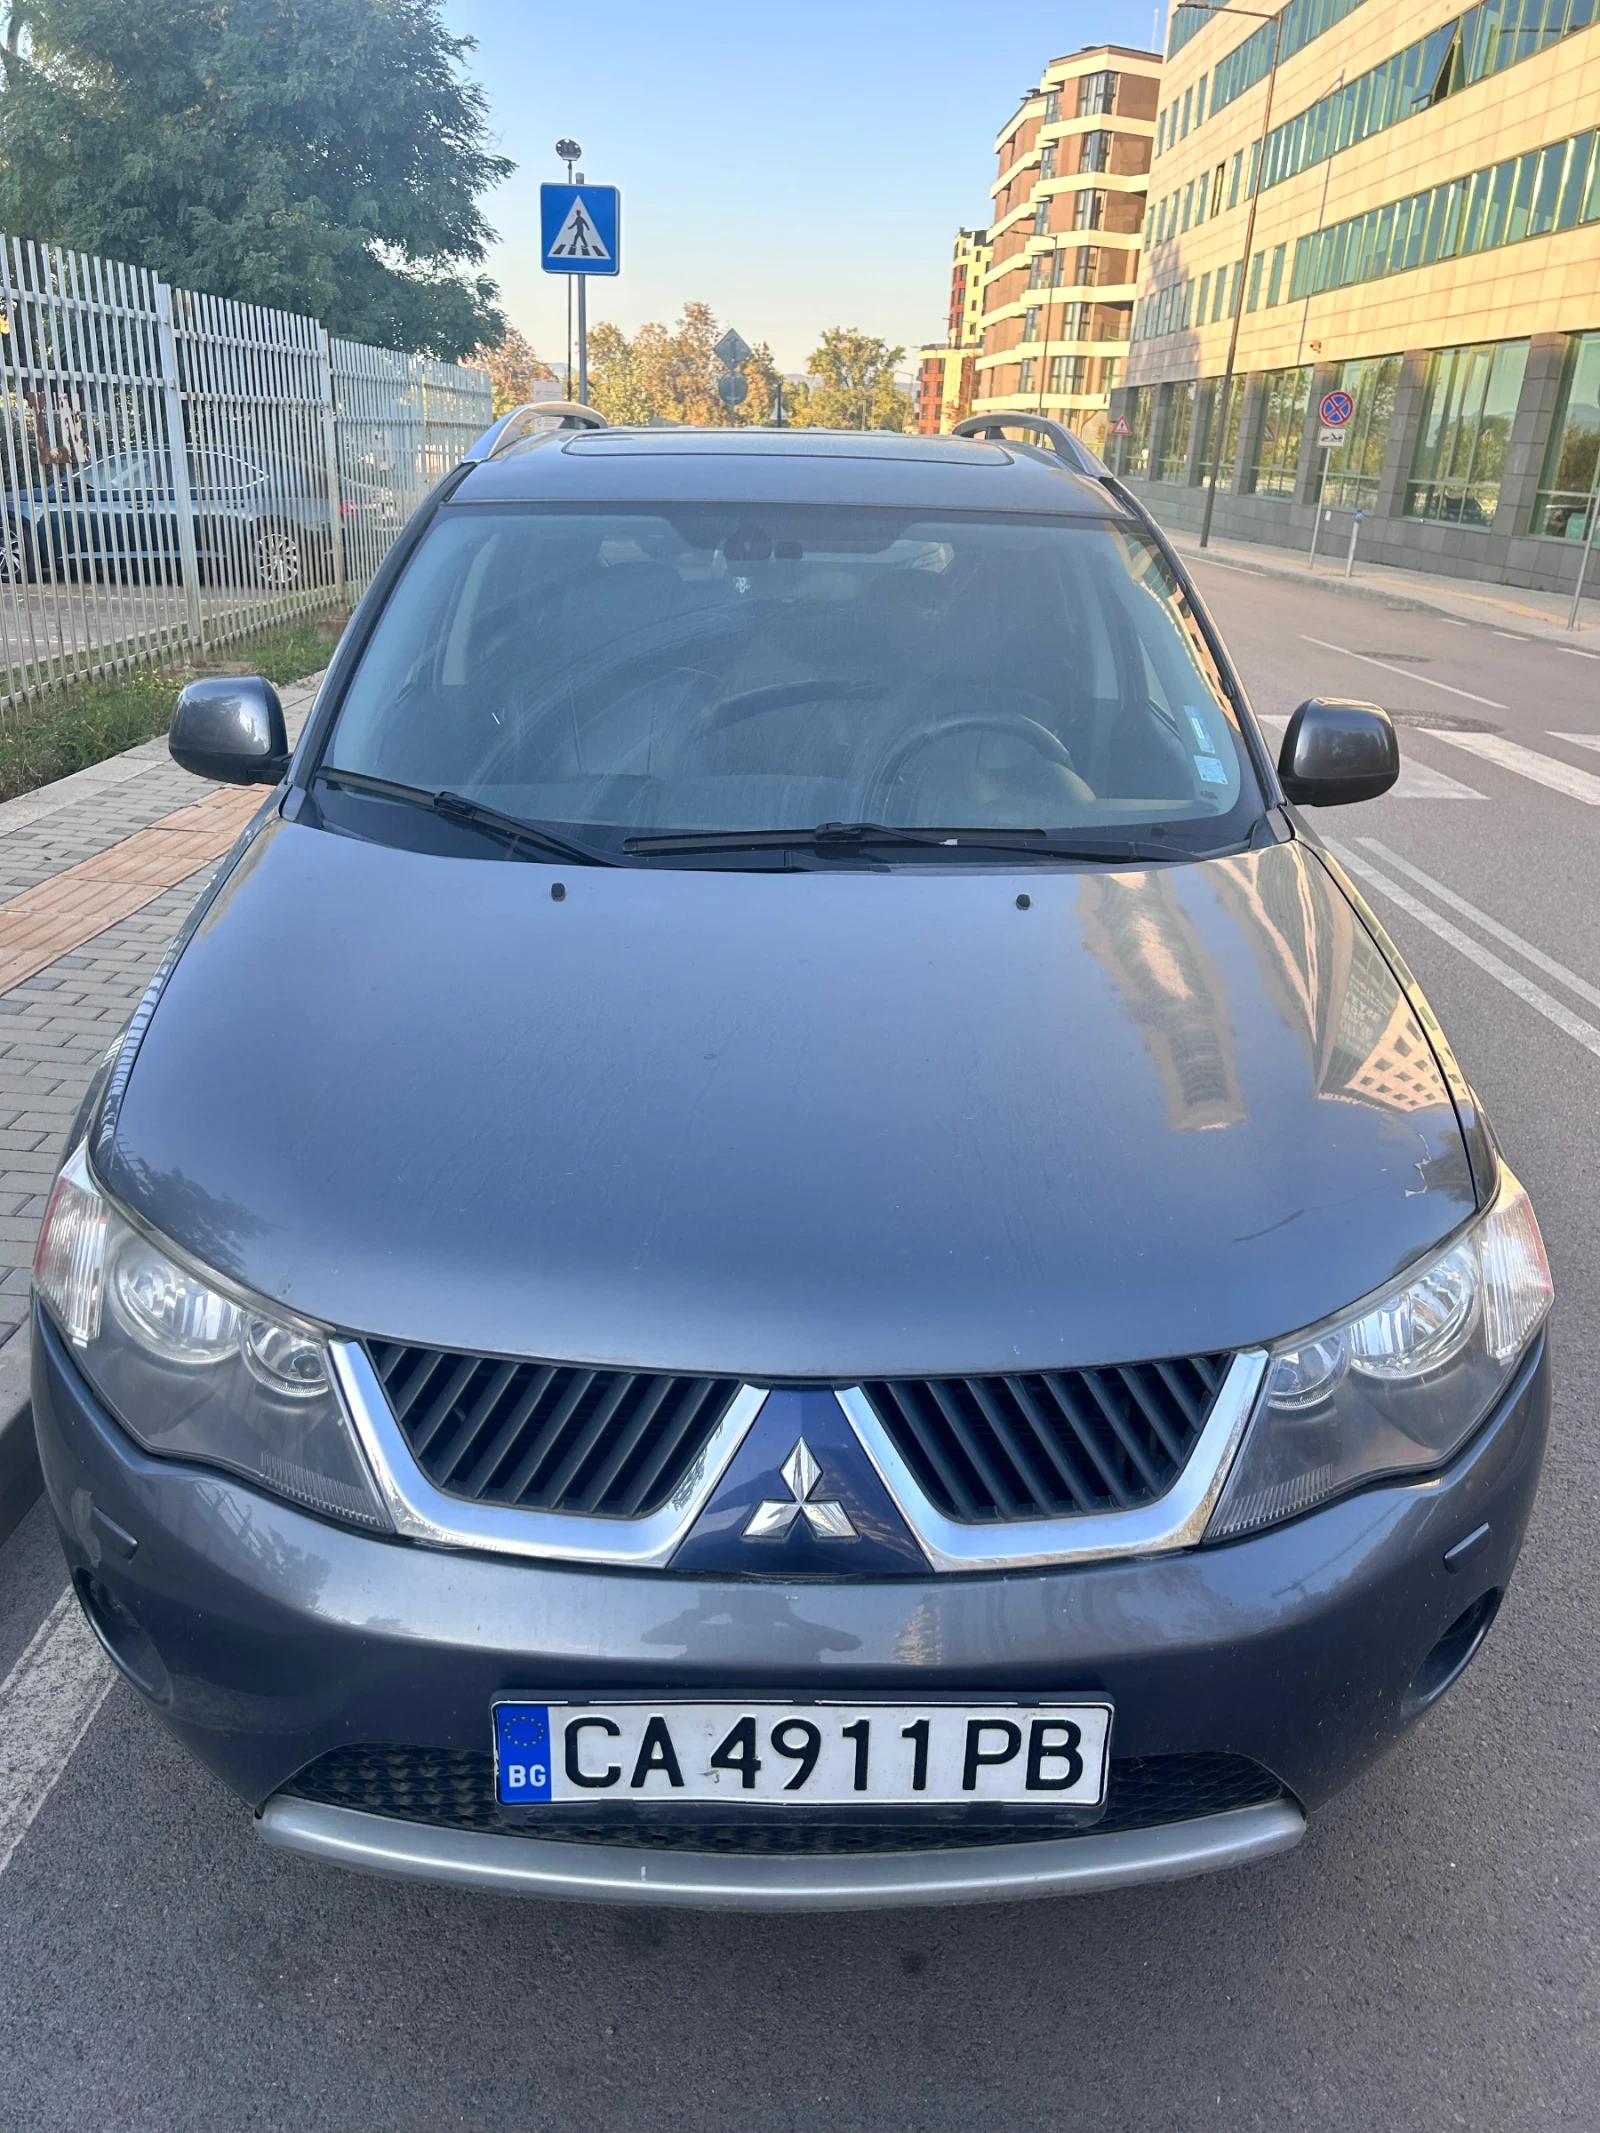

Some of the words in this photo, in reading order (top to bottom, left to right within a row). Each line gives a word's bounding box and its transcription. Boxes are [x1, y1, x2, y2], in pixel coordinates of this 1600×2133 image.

[508, 1764, 547, 1787] BG
[564, 1714, 685, 1788] CA
[710, 1714, 930, 1791] 4911
[962, 1718, 1084, 1791] PB
